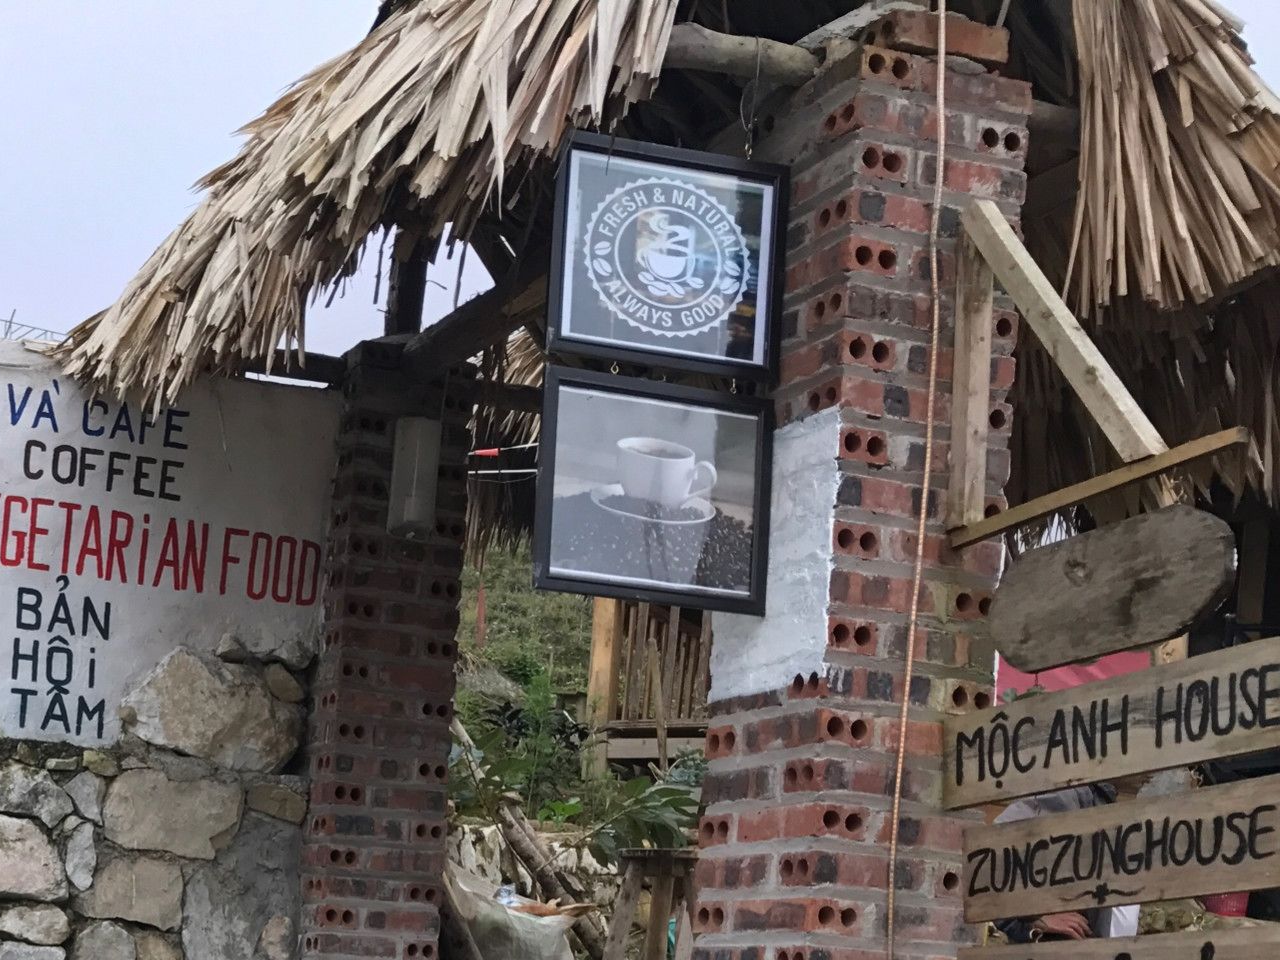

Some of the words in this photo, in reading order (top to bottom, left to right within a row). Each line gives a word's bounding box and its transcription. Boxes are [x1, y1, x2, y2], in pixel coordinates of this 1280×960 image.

[599, 190, 648, 237] FRESH
[653, 187, 666, 203] &
[672, 189, 741, 257] NATURAL
[605, 279, 672, 327] ALWAYS
[680, 294, 725, 327] GOOD
[7, 379, 60, 433] VÀ
[82, 399, 190, 449] CAFE
[23, 440, 185, 501] COFFEE
[220, 526, 322, 605] FOOD
[16, 575, 111, 641] BẢN
[956, 711, 1037, 789] MỘC
[1043, 695, 1129, 768] ANH
[1155, 663, 1280, 748] HOUSE
